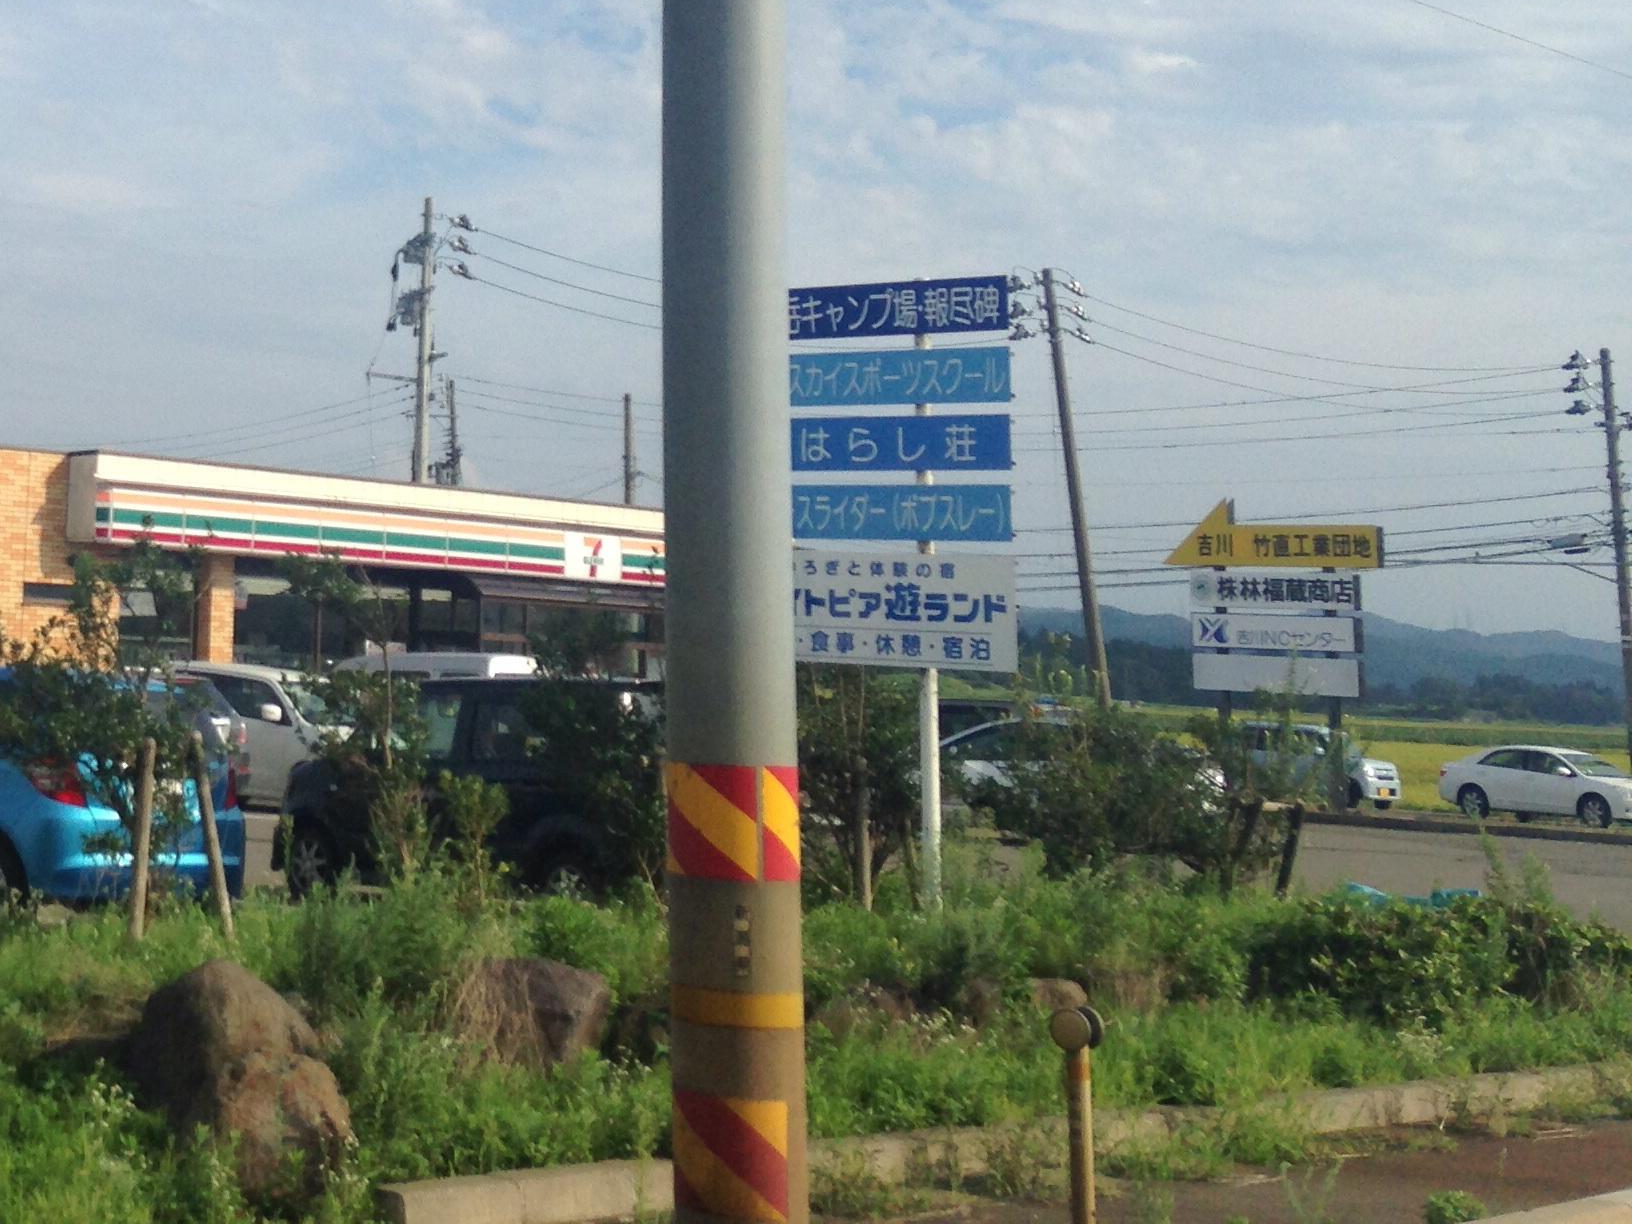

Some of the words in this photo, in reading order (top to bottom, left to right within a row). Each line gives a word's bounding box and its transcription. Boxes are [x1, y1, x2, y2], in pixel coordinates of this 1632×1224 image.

[1197, 534, 1233, 556] 吉川
[794, 582, 1007, 623] トピア遊ランド
